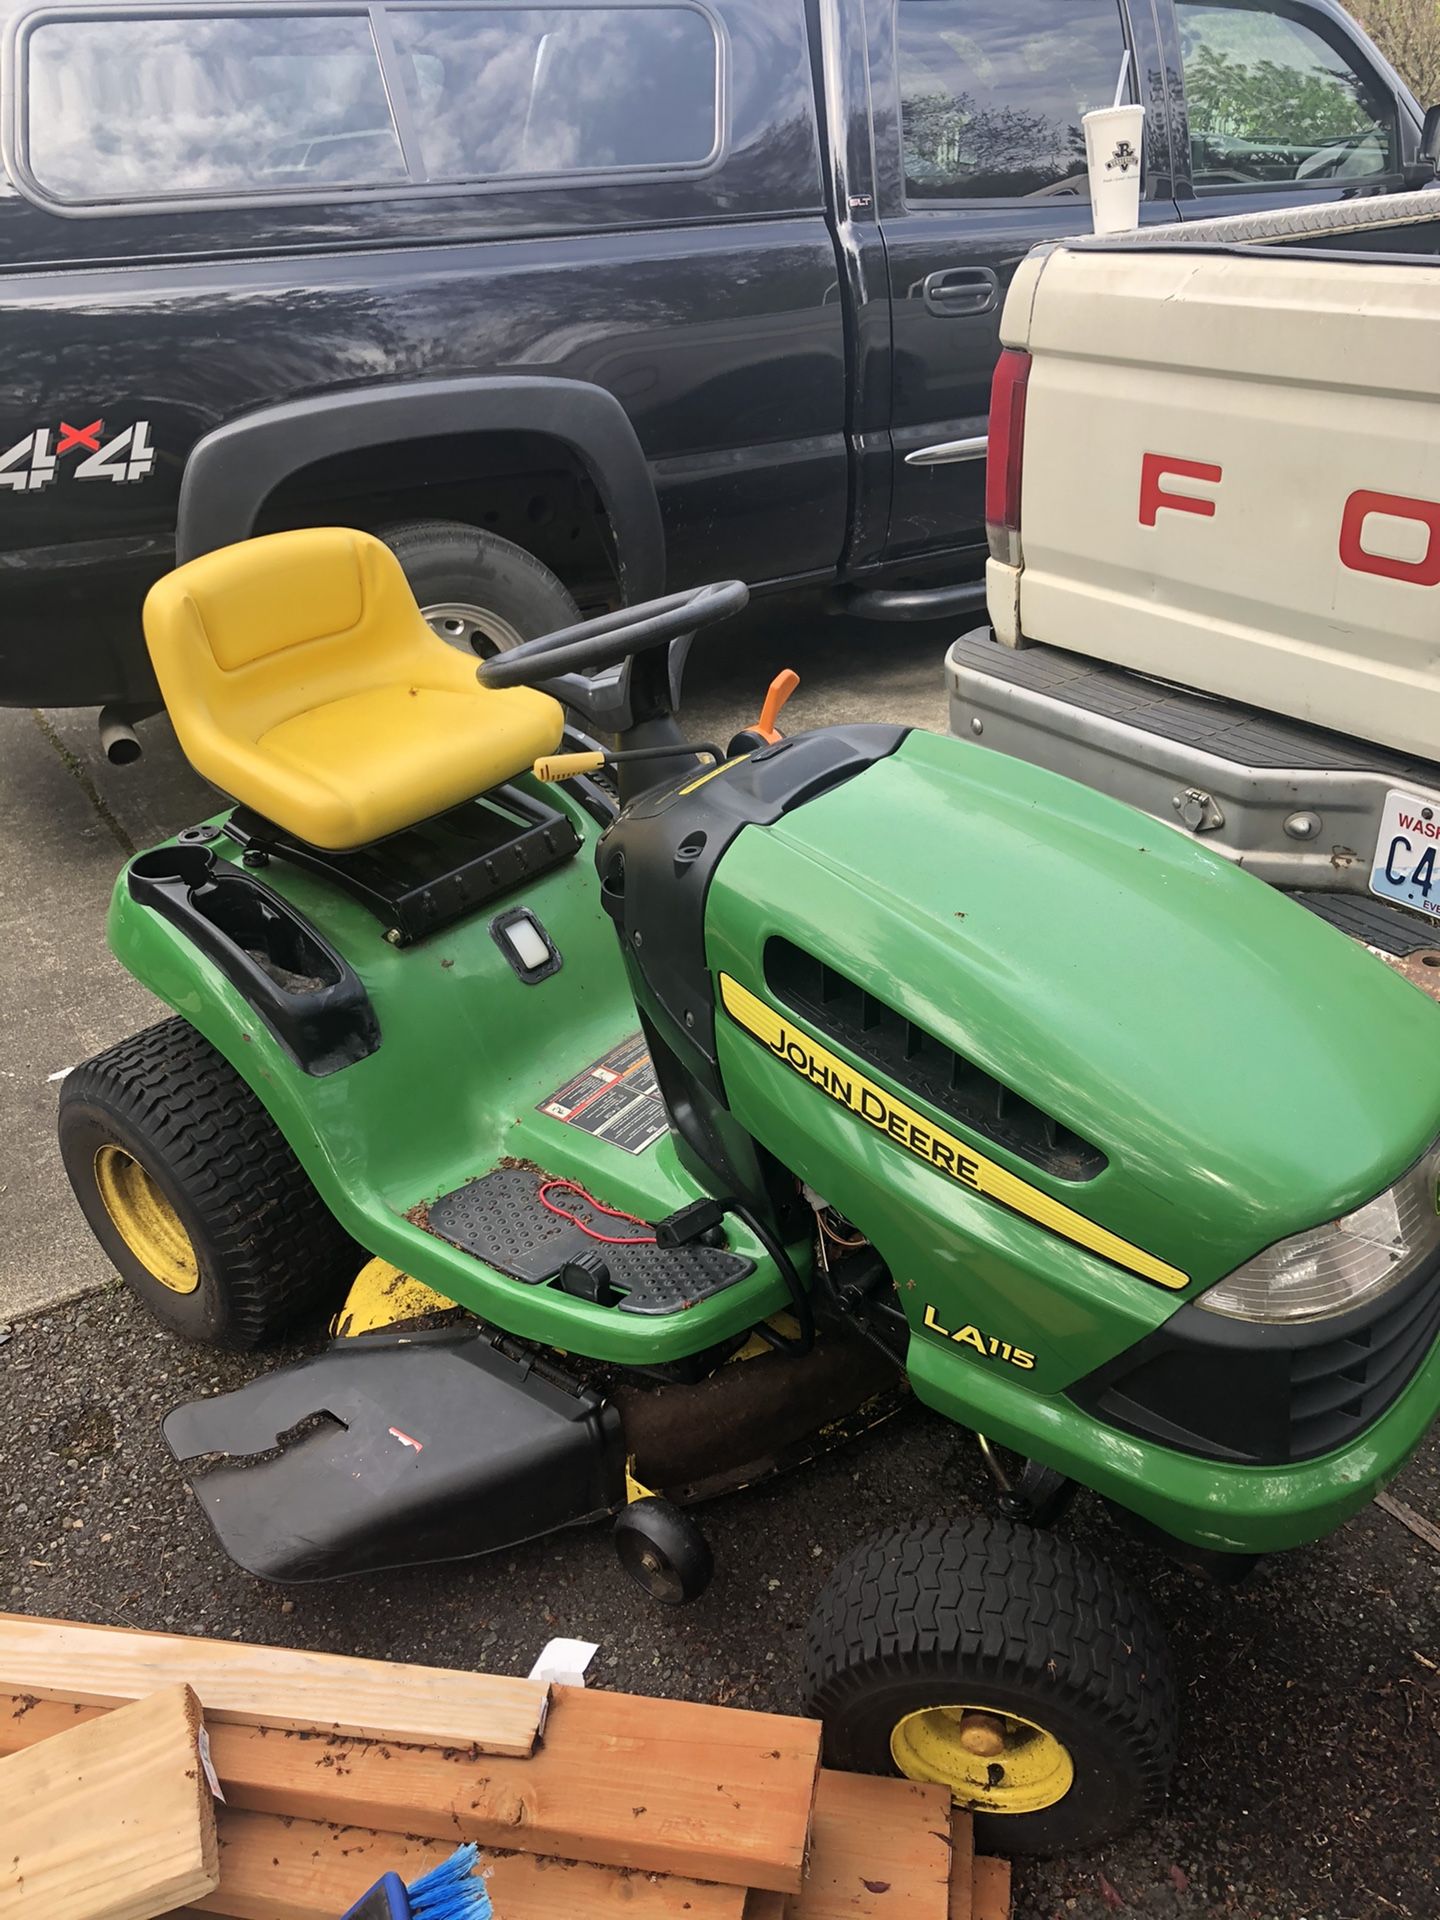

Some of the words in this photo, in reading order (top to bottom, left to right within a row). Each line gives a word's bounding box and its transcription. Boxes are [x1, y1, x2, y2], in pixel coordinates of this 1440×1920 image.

[1139, 452, 1440, 587] FO
[1385, 836, 1437, 897] C4
[769, 1028, 852, 1106] JOHN
[861, 1086, 979, 1186] DEERE
[924, 1304, 1036, 1370] LA115
